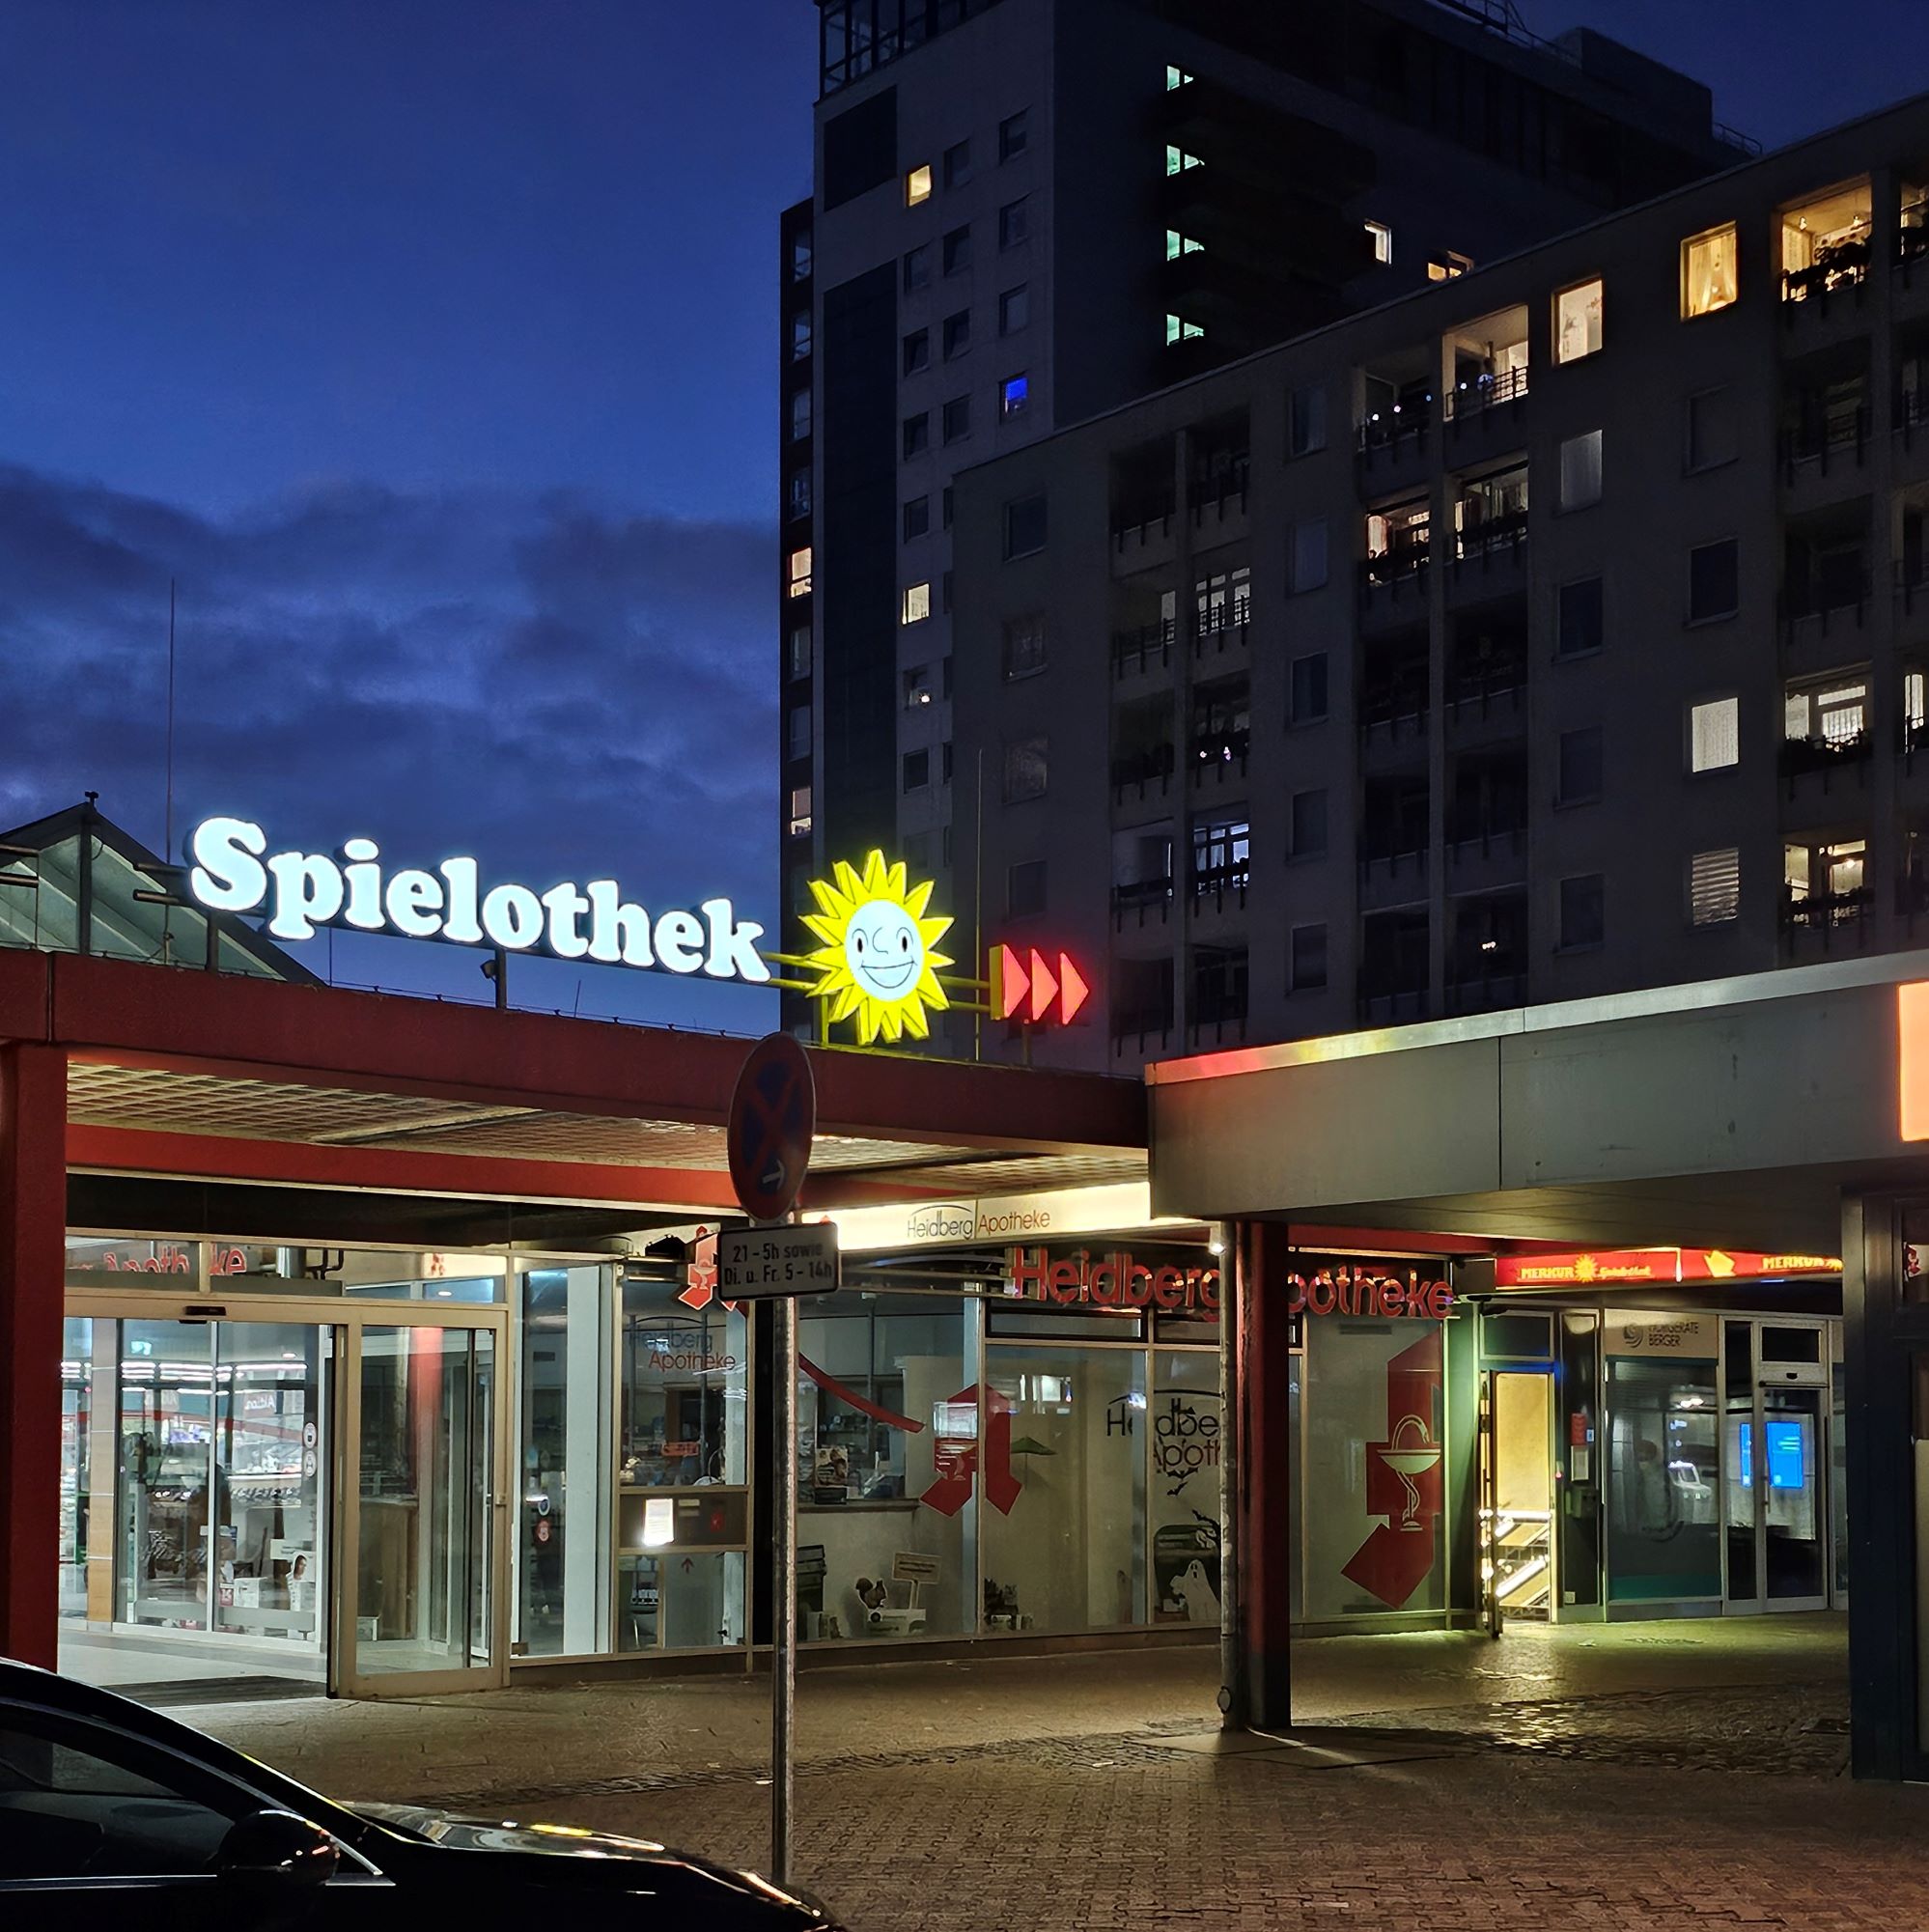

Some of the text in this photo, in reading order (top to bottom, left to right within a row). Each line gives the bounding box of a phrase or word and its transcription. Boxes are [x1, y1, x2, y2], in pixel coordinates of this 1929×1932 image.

[190, 817, 771, 983] Spielothek
[908, 1210, 1050, 1241] Heidberg Apotheke
[733, 1245, 747, 1263] 21
[763, 1243, 779, 1260] 5h
[784, 1244, 824, 1258] sowie
[1762, 1256, 1824, 1270] MERKUR
[724, 1267, 741, 1286] Di.
[786, 1263, 793, 1280] 5
[1521, 1267, 1574, 1279] MERKUR
[1288, 1265, 1454, 1320] potheke
[630, 1321, 713, 1354] Hedberg
[649, 1351, 736, 1372] Apotheke
